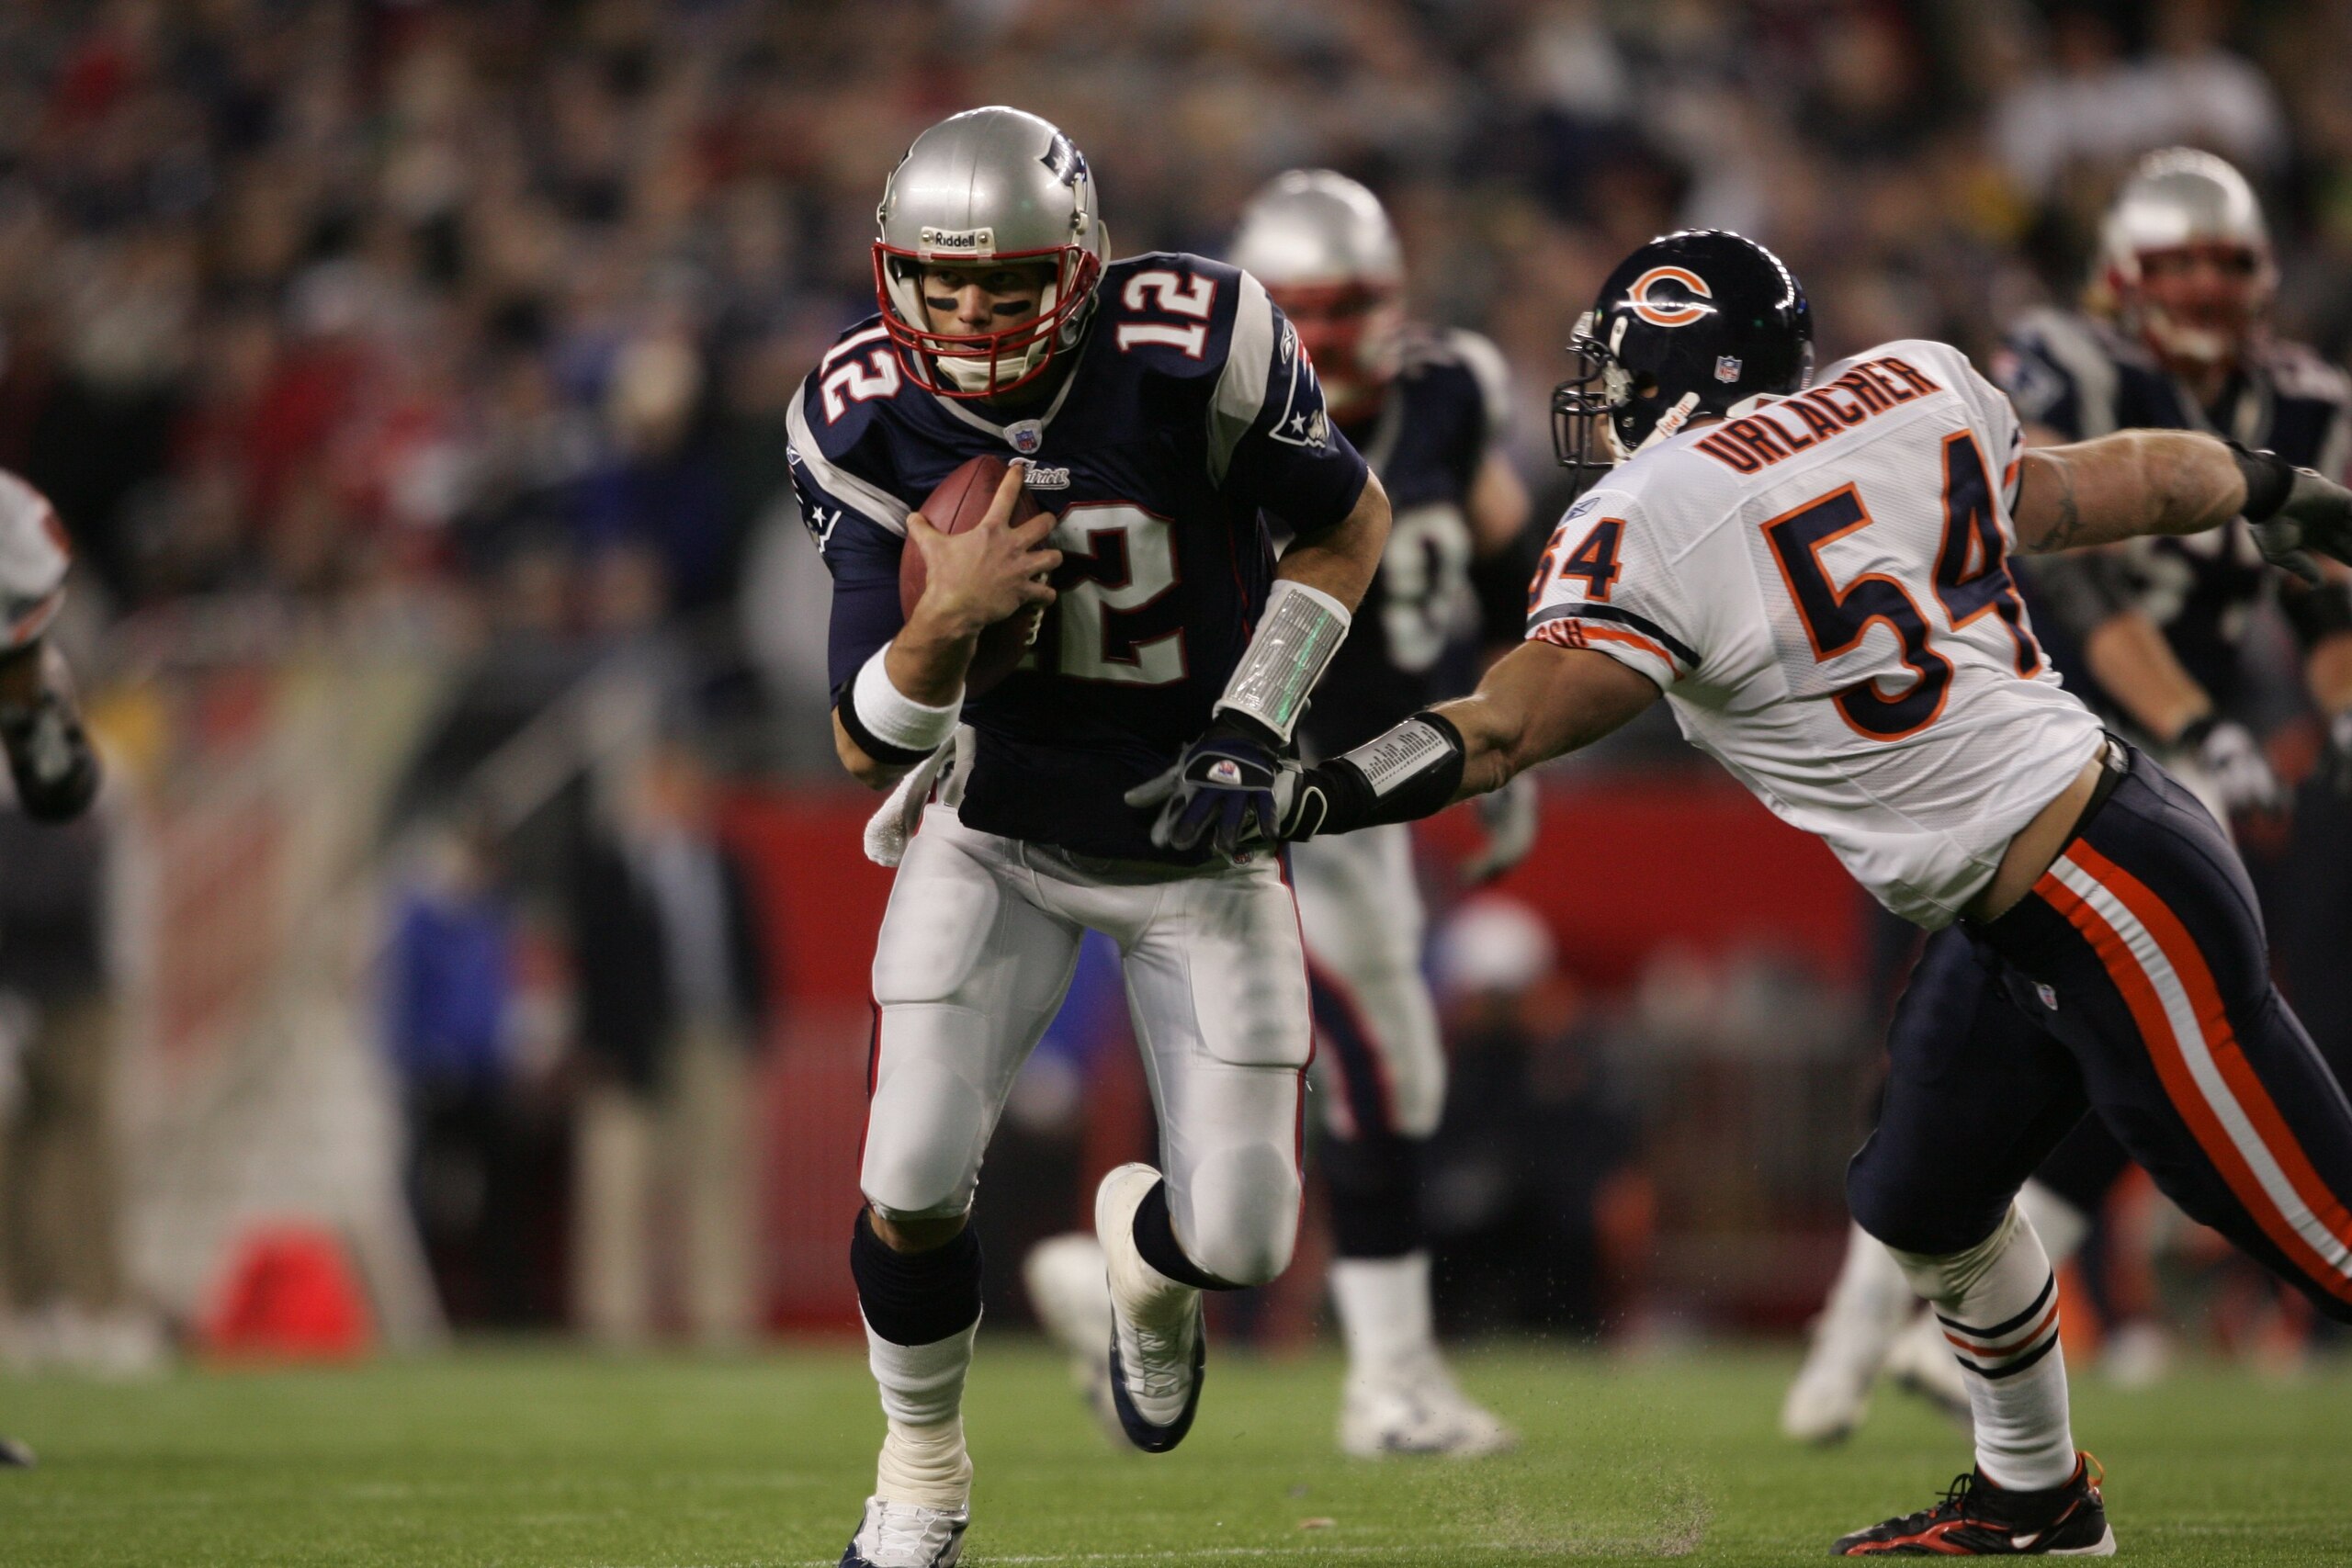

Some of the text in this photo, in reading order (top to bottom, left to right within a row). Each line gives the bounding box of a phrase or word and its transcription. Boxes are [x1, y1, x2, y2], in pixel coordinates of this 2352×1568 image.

[935, 231, 977, 247] Riddell
[1114, 268, 1218, 361] 12
[1626, 266, 1713, 327] C
[819, 321, 903, 426] 12
[1693, 356, 1943, 475] URLACHER
[1016, 501, 1189, 686] 2
[1758, 428, 2042, 742] 54
